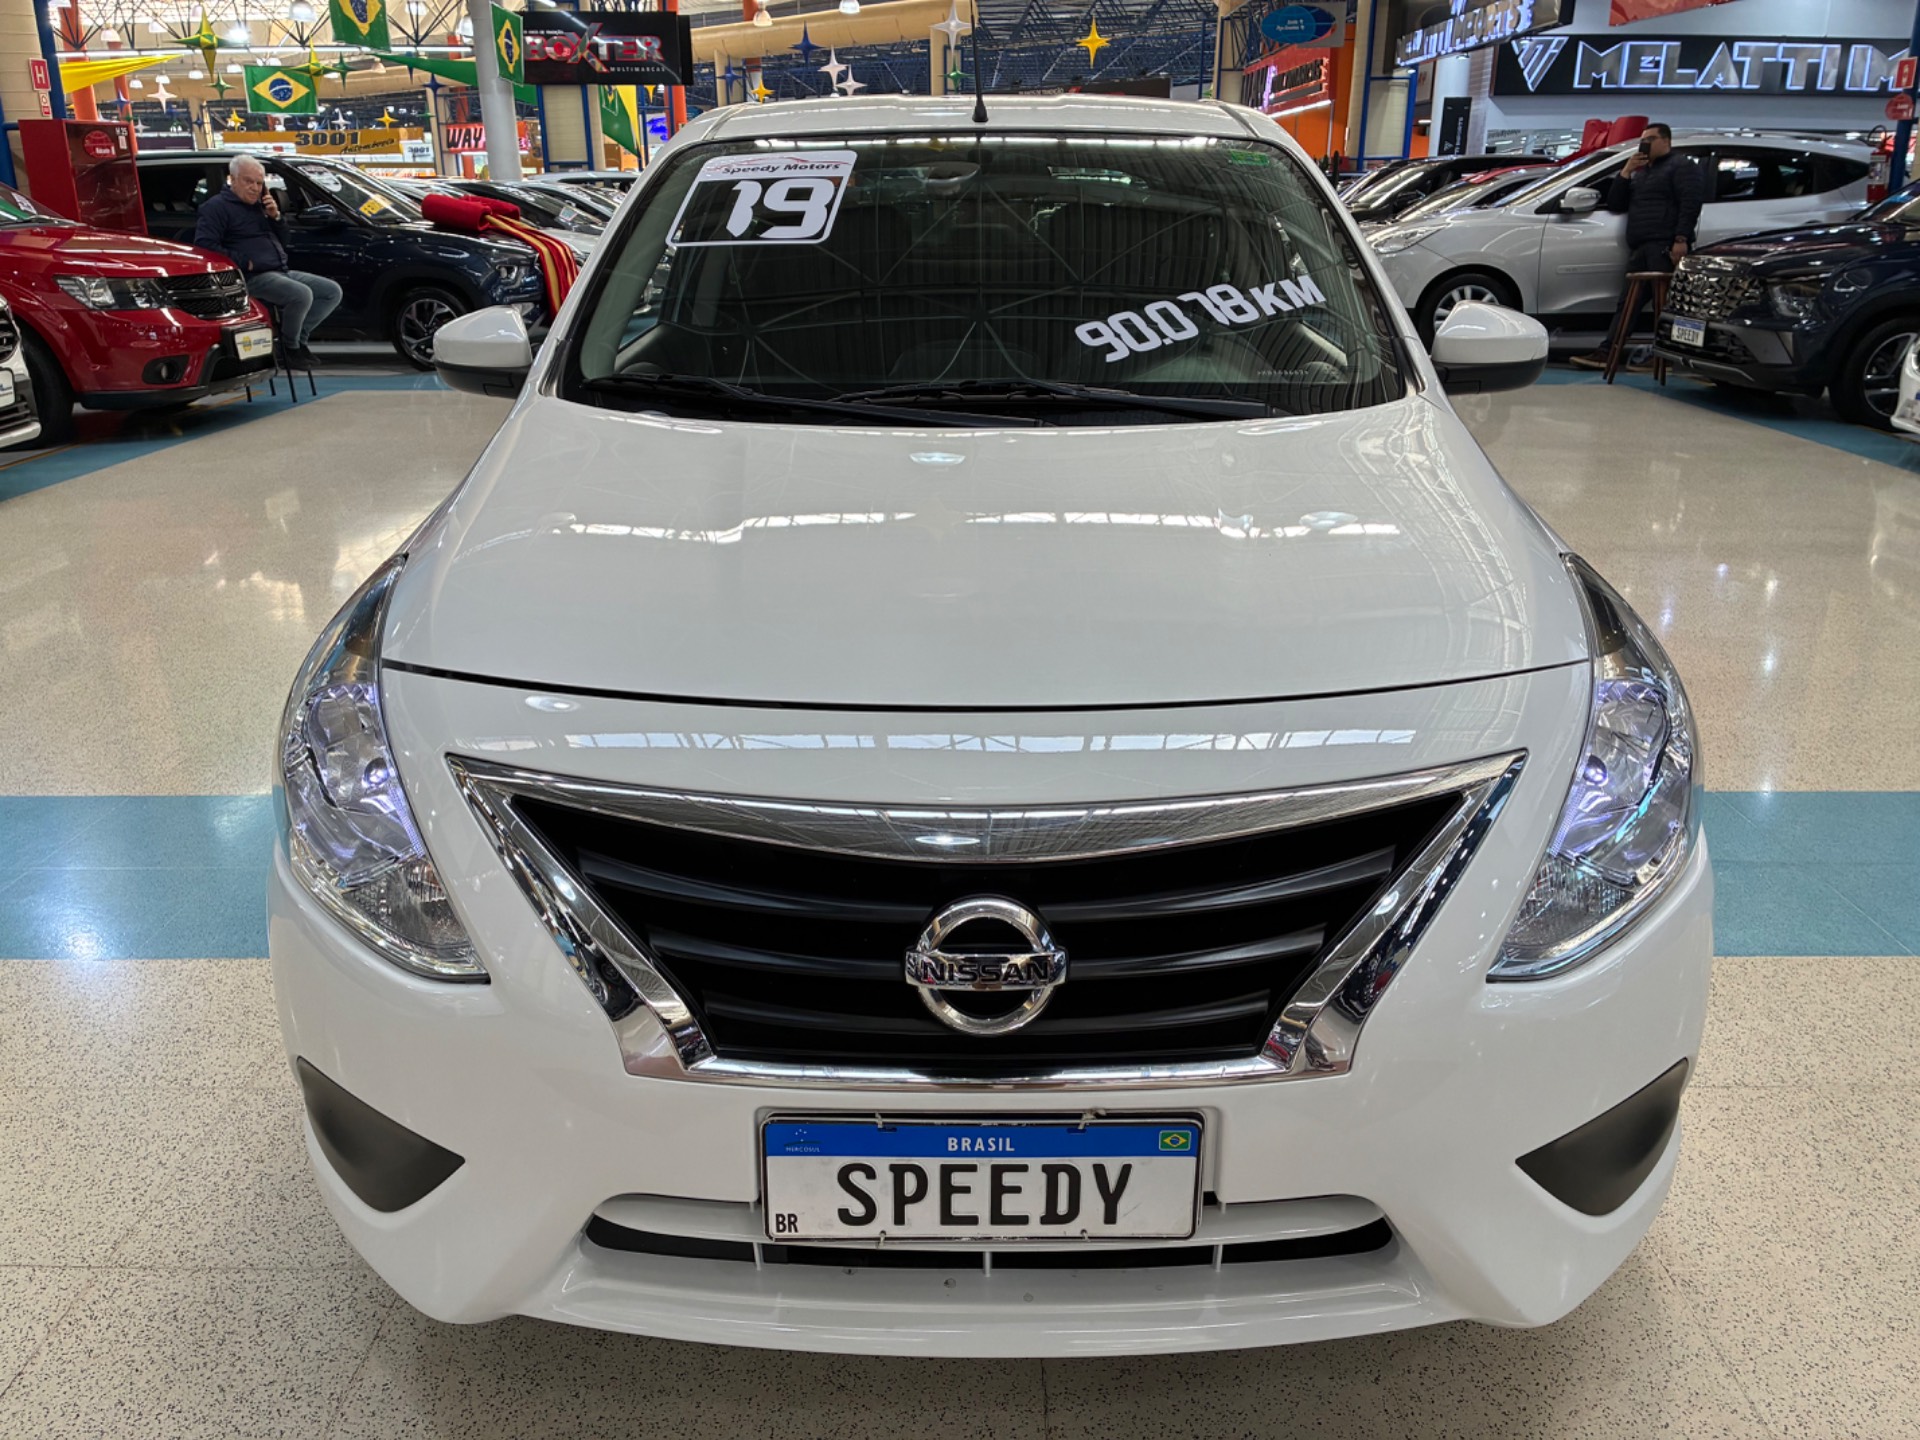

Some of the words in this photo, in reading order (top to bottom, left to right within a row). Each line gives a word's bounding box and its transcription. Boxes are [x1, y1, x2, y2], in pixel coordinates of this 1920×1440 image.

[524, 23, 664, 72] BOXTER
[35, 65, 46, 84] H
[1573, 41, 1841, 90] MELATTI
[295, 131, 358, 146] 3001
[447, 127, 483, 149] WAY
[722, 164, 779, 175] Speedy
[783, 163, 841, 171] Motors
[726, 178, 835, 239] 19
[921, 961, 1050, 985] NISSAN
[947, 1136, 1016, 1152] BRASIL
[836, 1162, 1133, 1226] SPEEDY
[775, 1213, 799, 1234] BR
